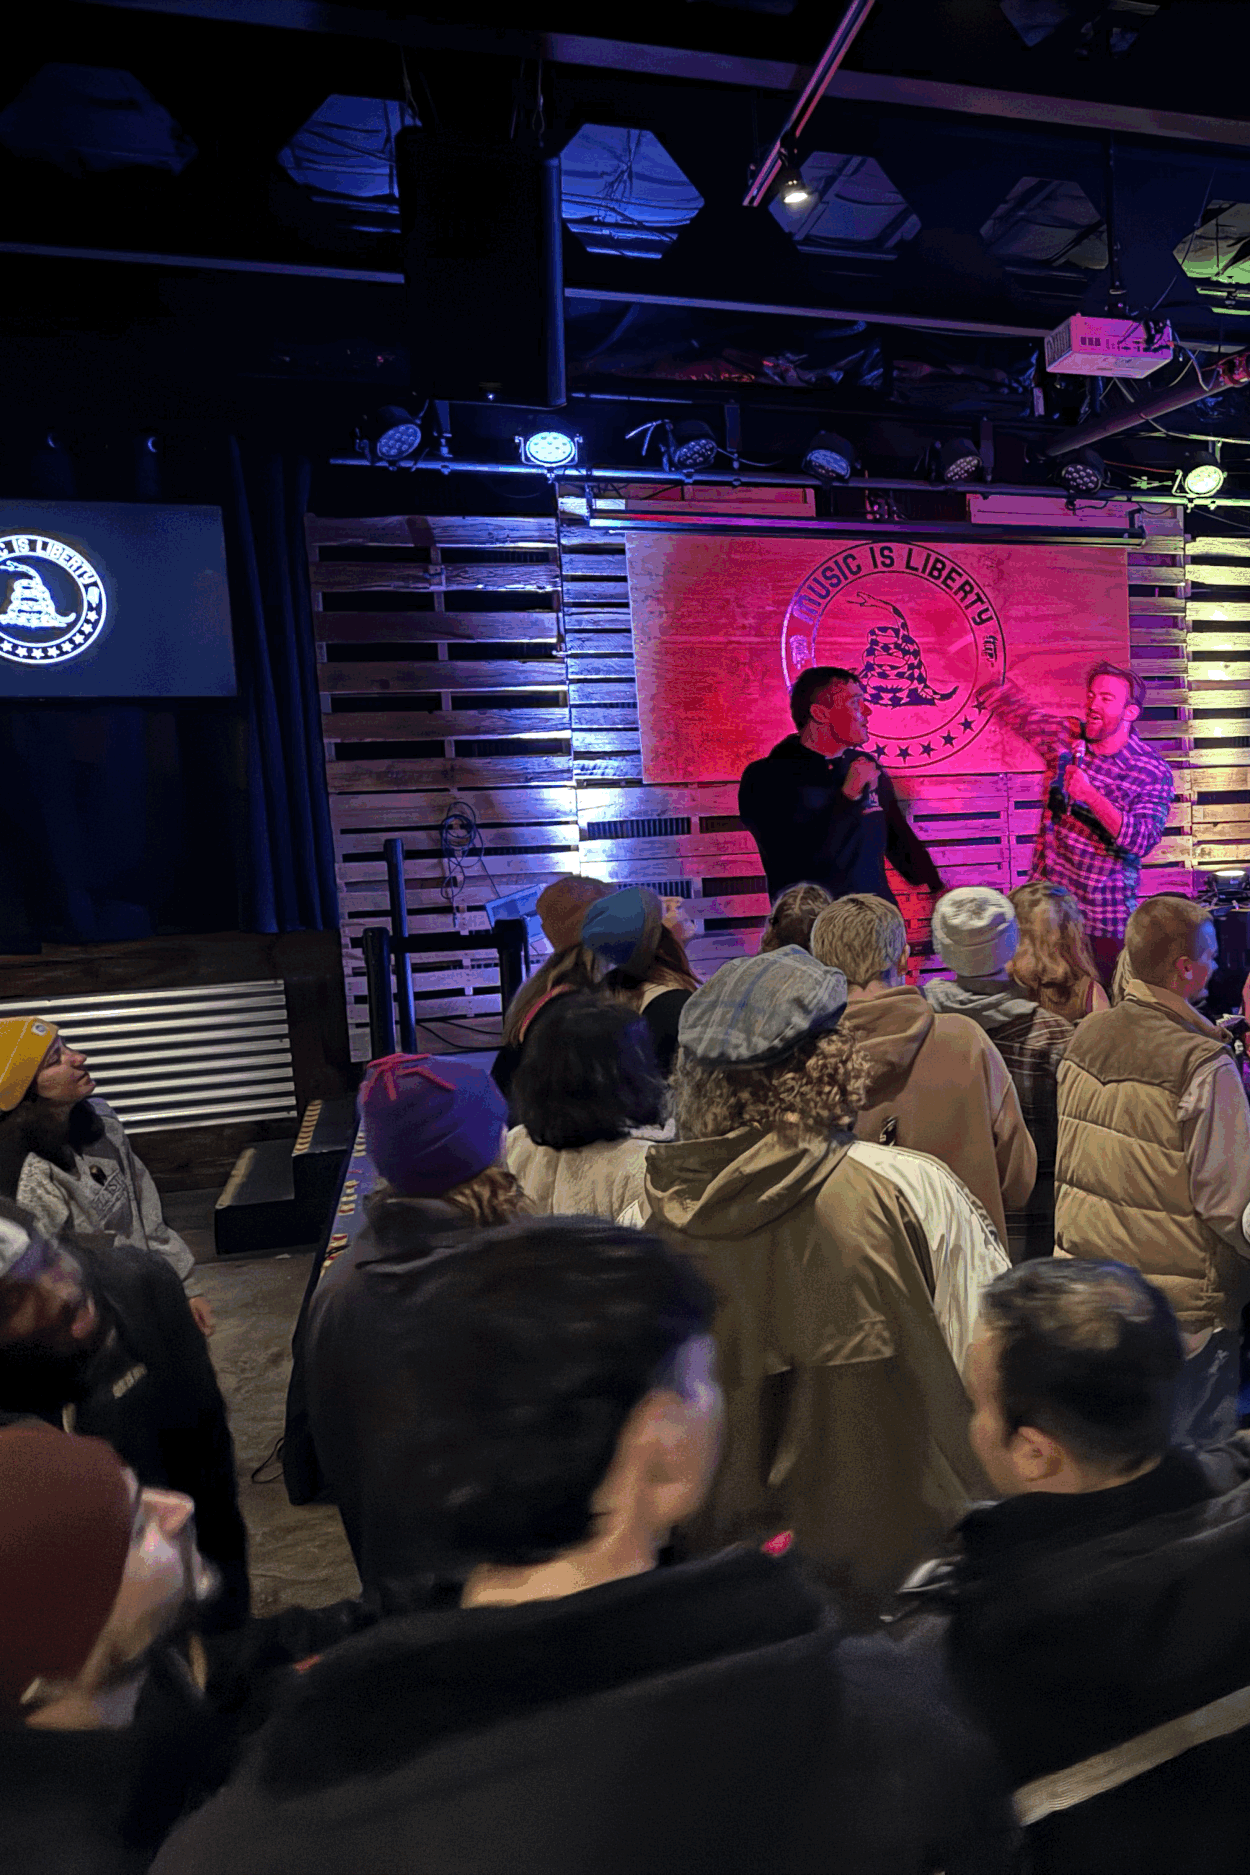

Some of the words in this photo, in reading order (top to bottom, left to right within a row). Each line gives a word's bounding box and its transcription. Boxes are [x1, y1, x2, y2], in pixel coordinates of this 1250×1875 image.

[11, 538, 30, 554] IS
[36, 540, 97, 585] LIBERTY
[792, 553, 862, 625] MUSIC
[869, 545, 895, 569] IS
[905, 547, 994, 627] LIBERTY
